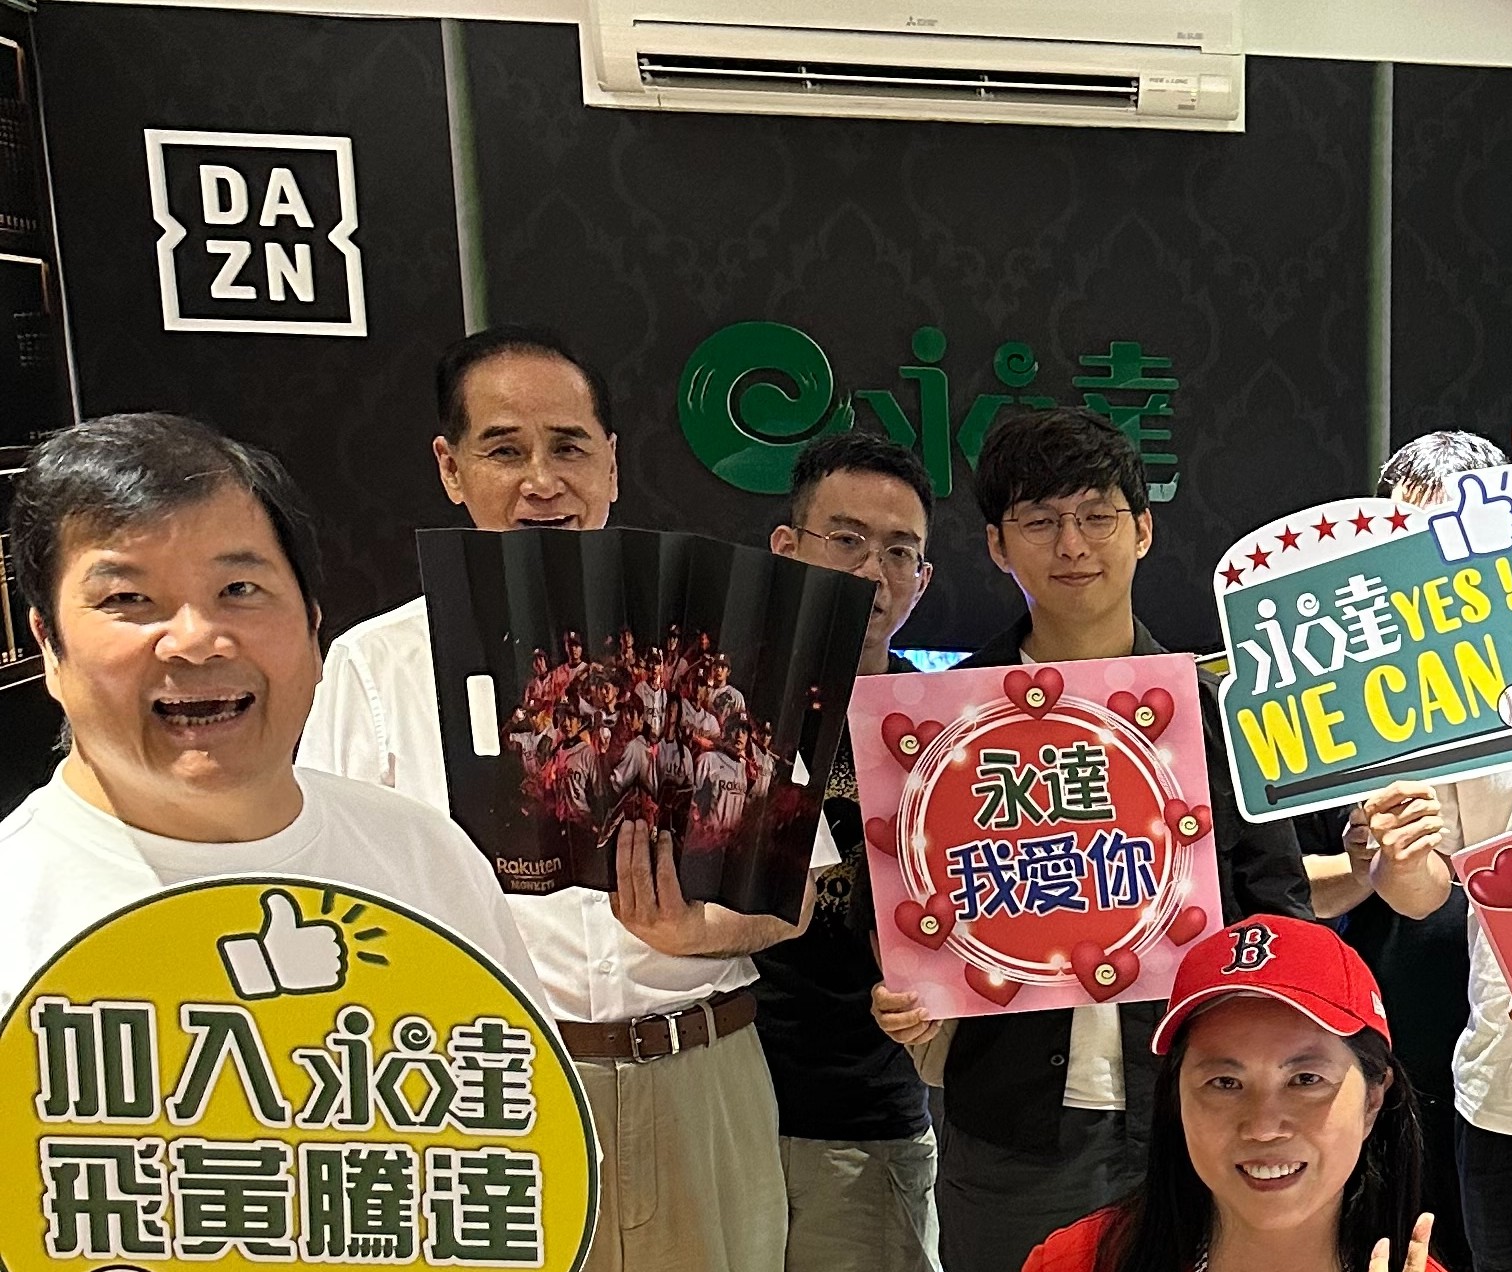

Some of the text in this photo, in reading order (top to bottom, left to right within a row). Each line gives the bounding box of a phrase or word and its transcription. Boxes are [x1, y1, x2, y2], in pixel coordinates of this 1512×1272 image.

[1237, 575, 1401, 695] 永達
[1237, 682, 1357, 781] WE
[972, 744, 1114, 830] 永達
[496, 857, 562, 875] Rakuten
[947, 831, 1157, 923] 我愛你
[1223, 923, 1279, 974] B
[36, 1000, 536, 1133] 加入永達
[45, 1140, 542, 1265] 飛黃騰達
